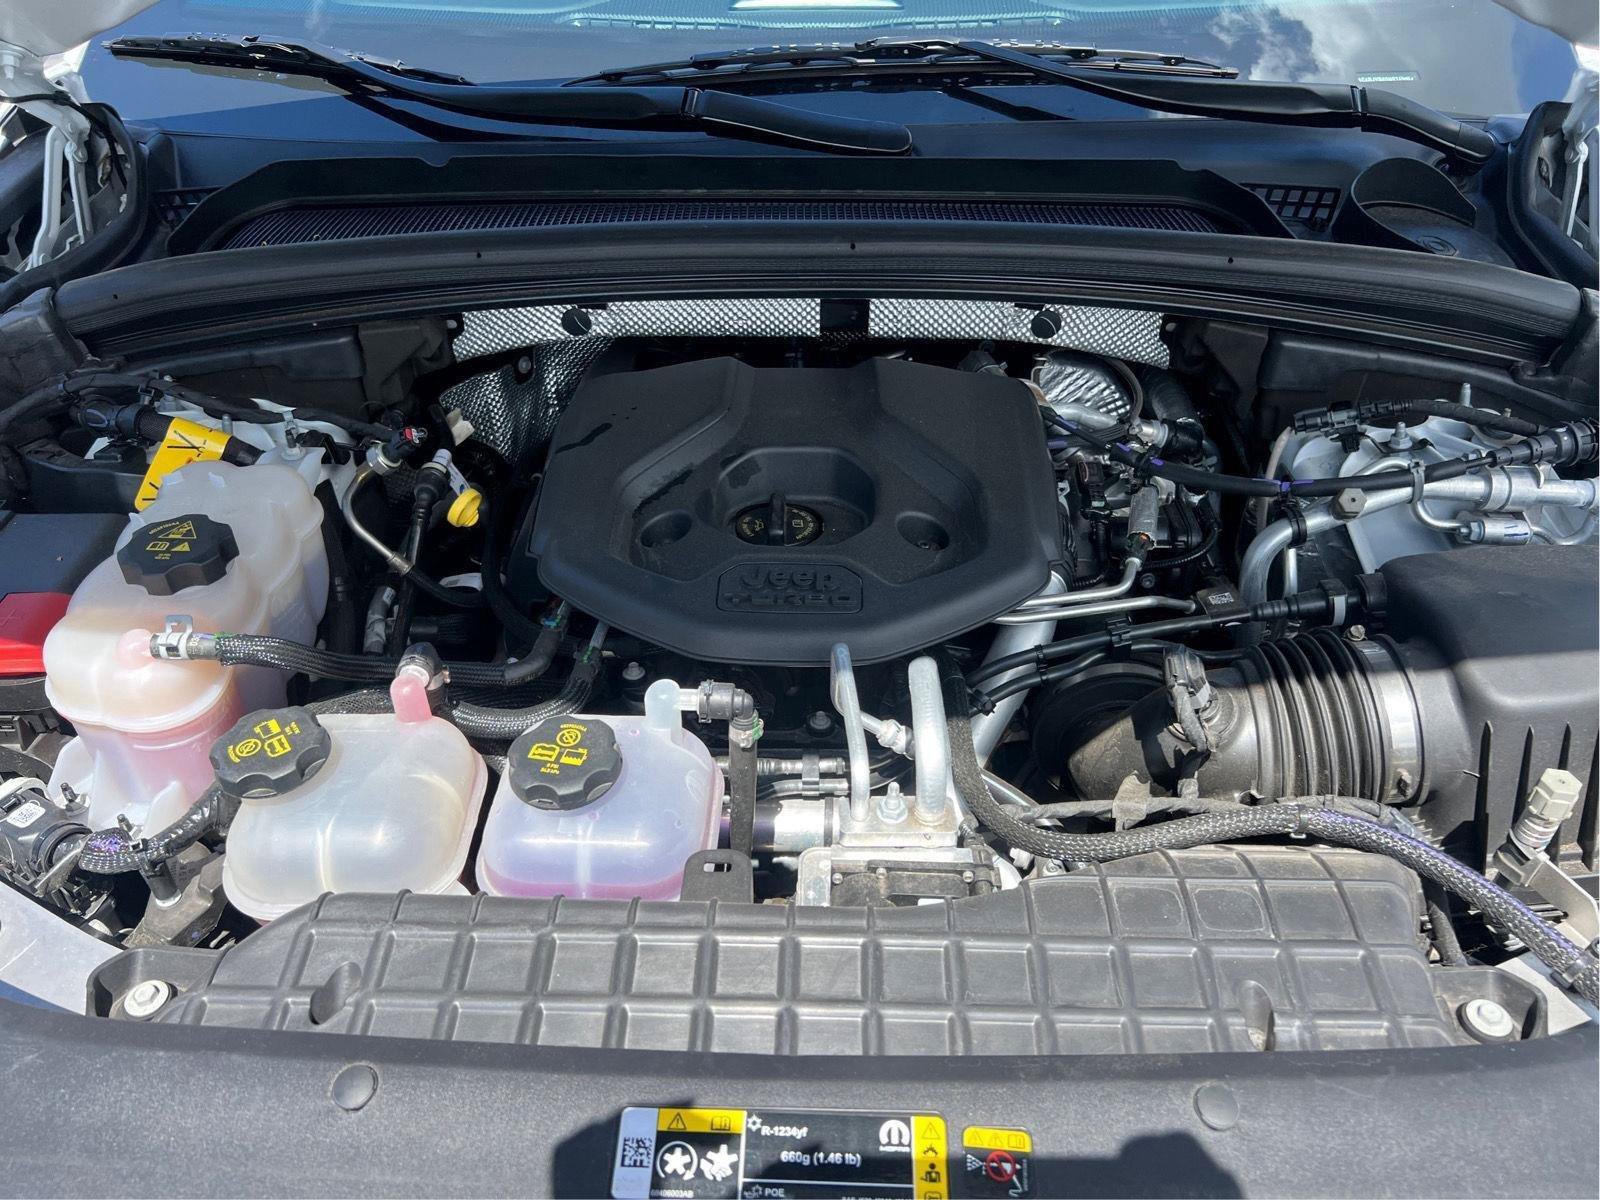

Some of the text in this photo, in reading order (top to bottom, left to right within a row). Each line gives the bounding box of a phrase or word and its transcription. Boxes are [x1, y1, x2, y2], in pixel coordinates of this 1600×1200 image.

[739, 566, 840, 591] Jeep
[761, 1125, 809, 1139] R-1234yf
[780, 1150, 862, 1168] 660g (1.46 lb)
[764, 1187, 785, 1197] POE
